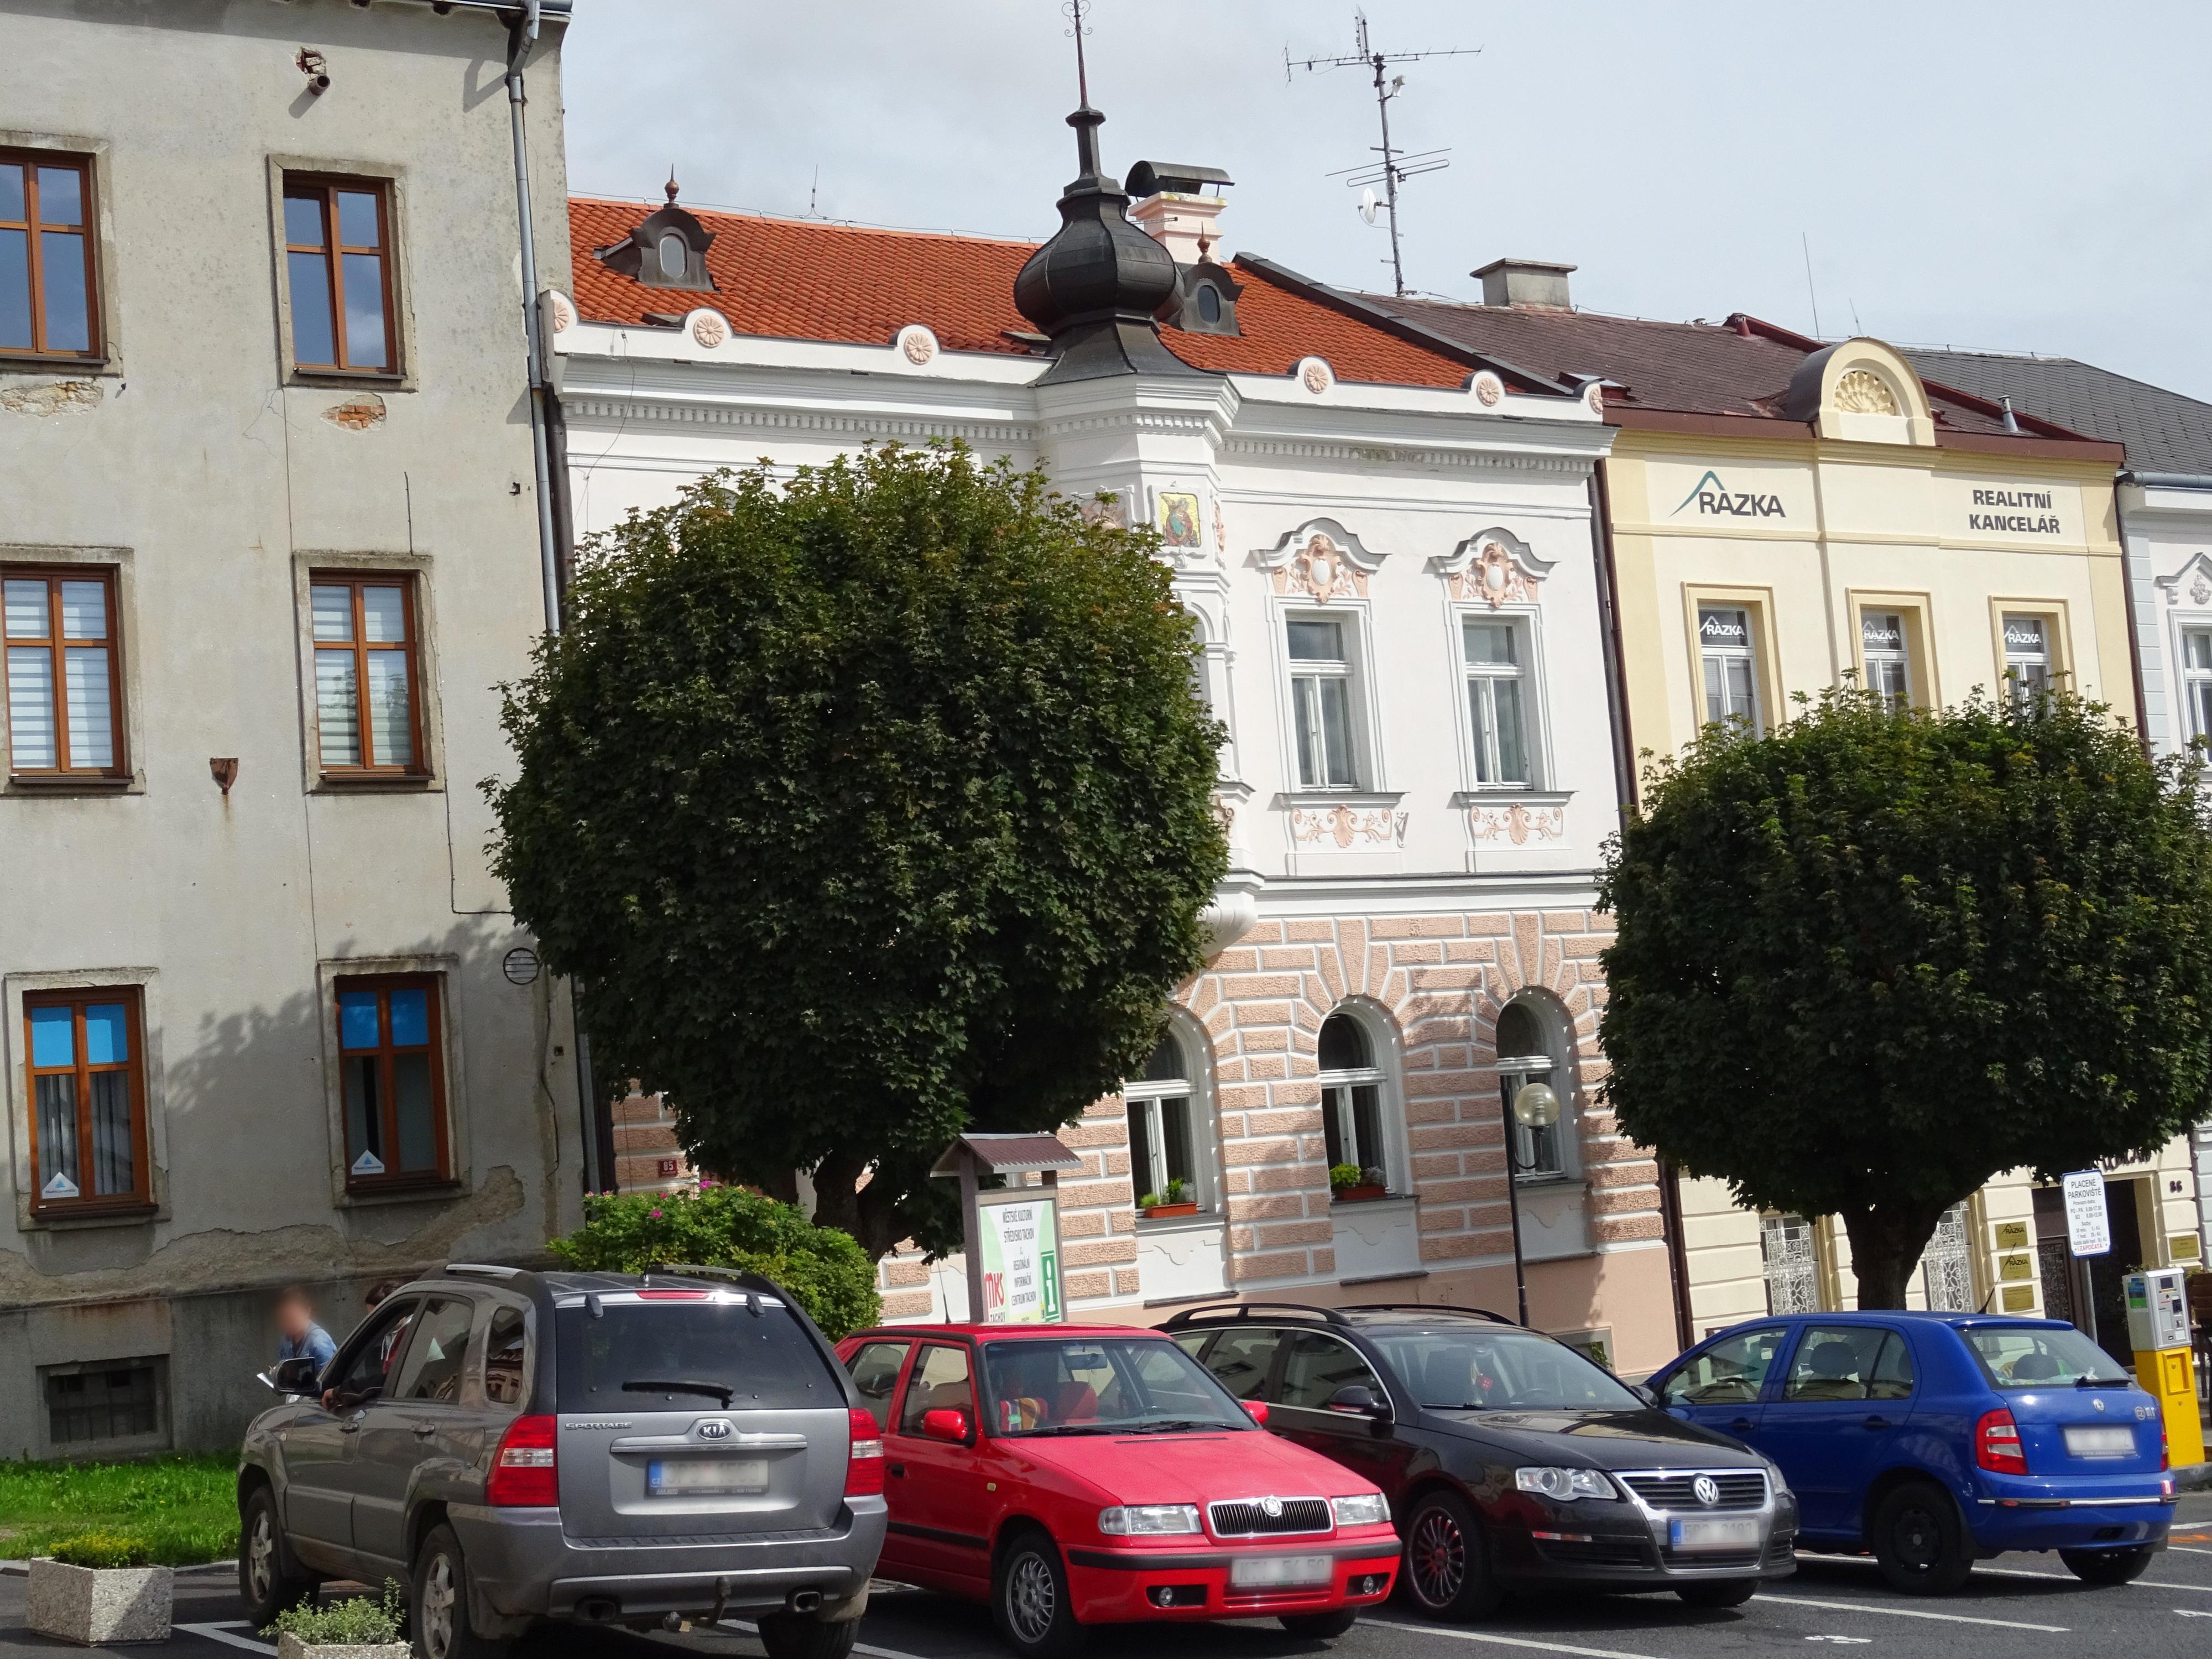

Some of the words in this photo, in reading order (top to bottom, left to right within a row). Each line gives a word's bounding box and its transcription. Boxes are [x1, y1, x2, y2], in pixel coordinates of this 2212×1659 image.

[1973, 489, 2052, 509] REALITNÍ
[1969, 514, 2060, 534] KANCELÁŘ
[663, 1161, 674, 1171] 85
[2070, 1178, 2097, 1188] PLACENÉ
[2068, 1187, 2102, 1199] PARKOVIŠTĚ
[1021, 1228, 1034, 1240] TACHOV
[990, 1312, 1005, 1322] TACHOV
[565, 1422, 633, 1431] SPORTAGE
[702, 1424, 727, 1437] KIA
